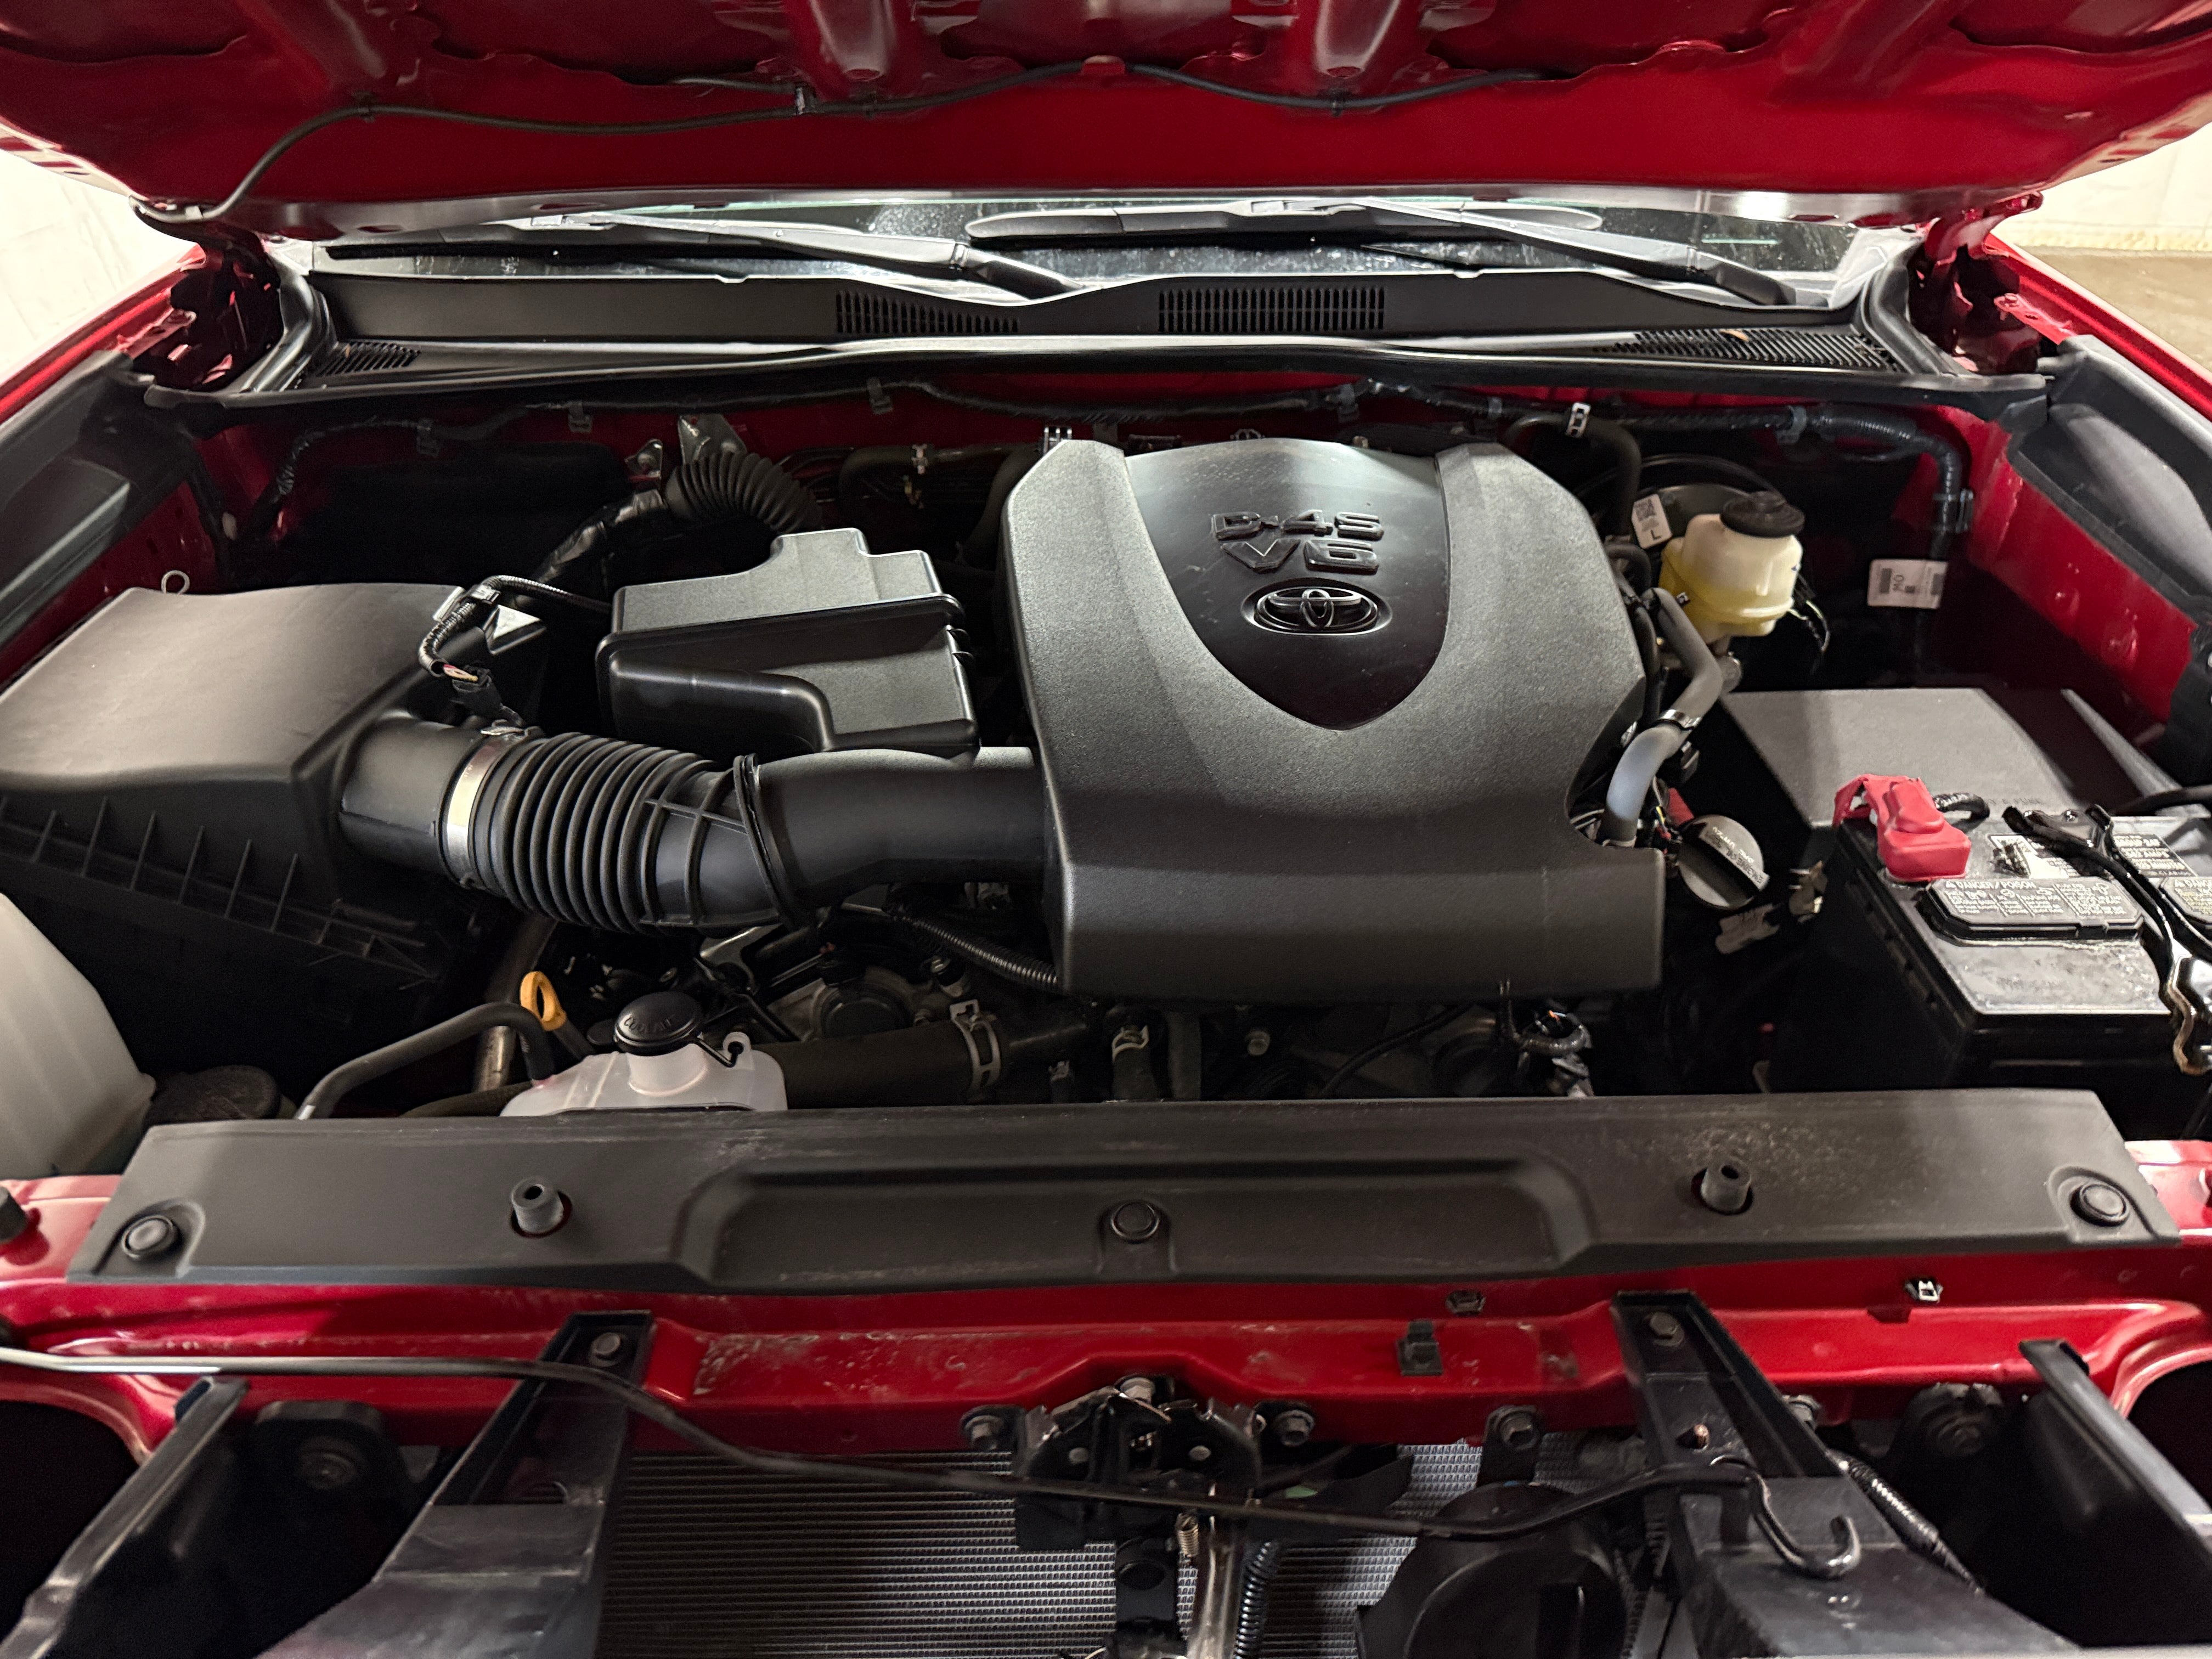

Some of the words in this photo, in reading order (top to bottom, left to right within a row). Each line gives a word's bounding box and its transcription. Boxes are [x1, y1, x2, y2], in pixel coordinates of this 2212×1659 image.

[1211, 509, 1384, 541] D-4S
[1651, 530, 1662, 540] L
[1221, 538, 1380, 575] V6
[1736, 858, 1763, 884] ENGINE
